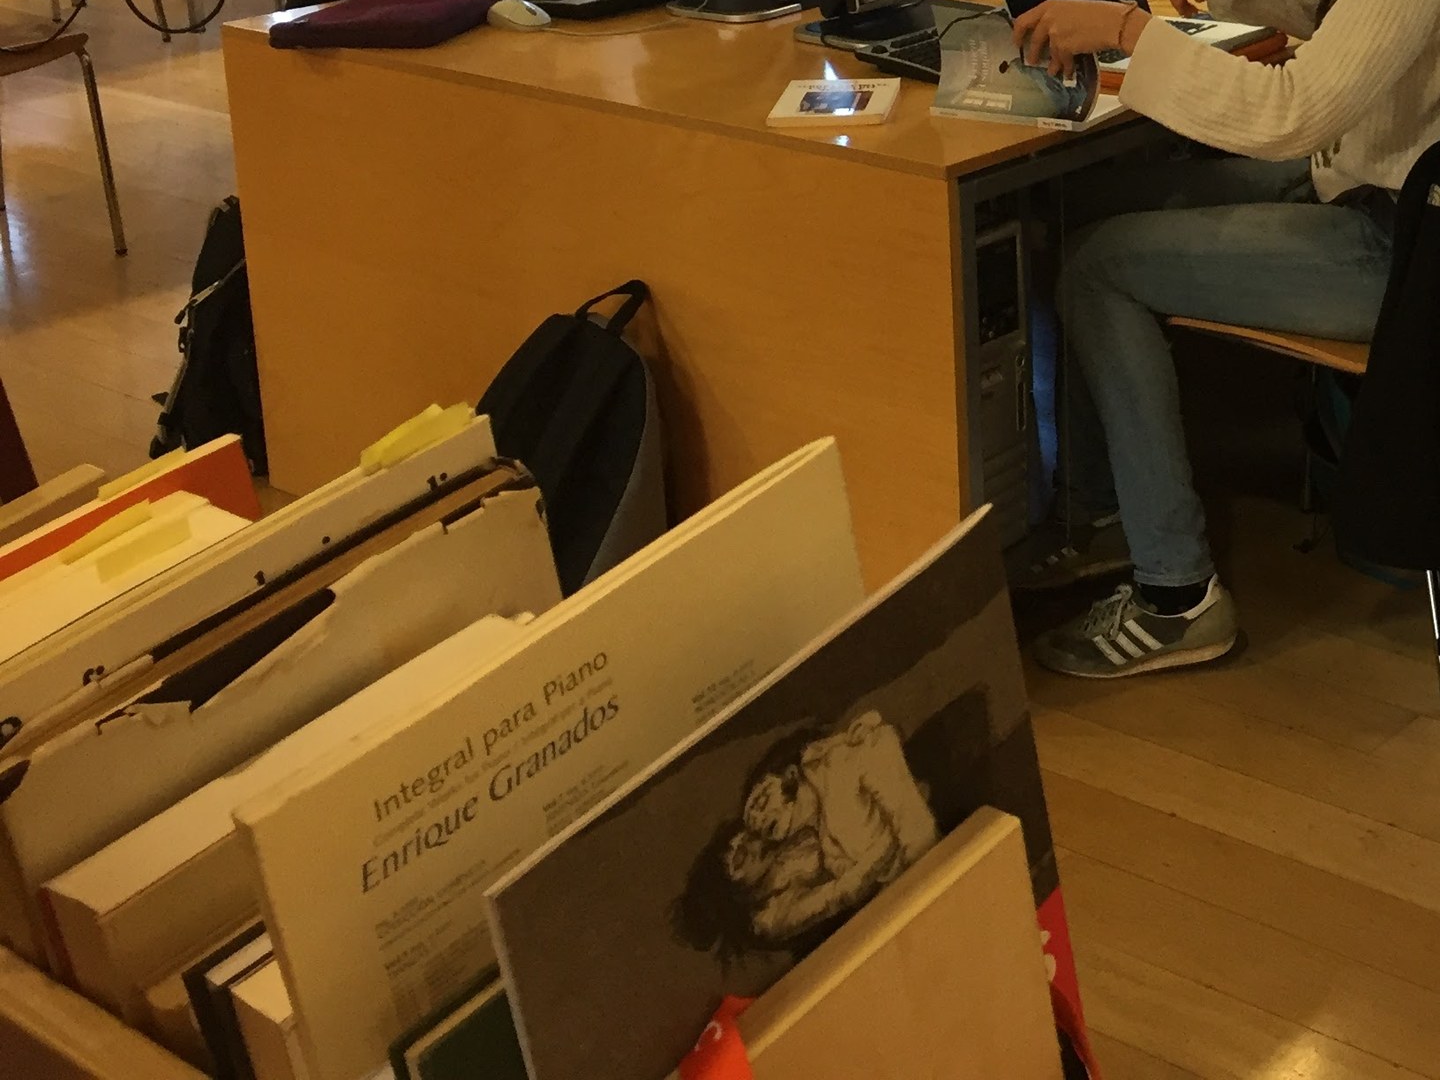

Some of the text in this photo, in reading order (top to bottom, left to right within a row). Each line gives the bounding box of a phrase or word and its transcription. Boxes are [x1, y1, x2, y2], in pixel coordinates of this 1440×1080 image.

[361, 795, 479, 895] Enrique
[488, 694, 620, 802] Granados
[373, 735, 475, 822] Integral
[481, 701, 537, 756] para
[541, 650, 608, 706] Piano
